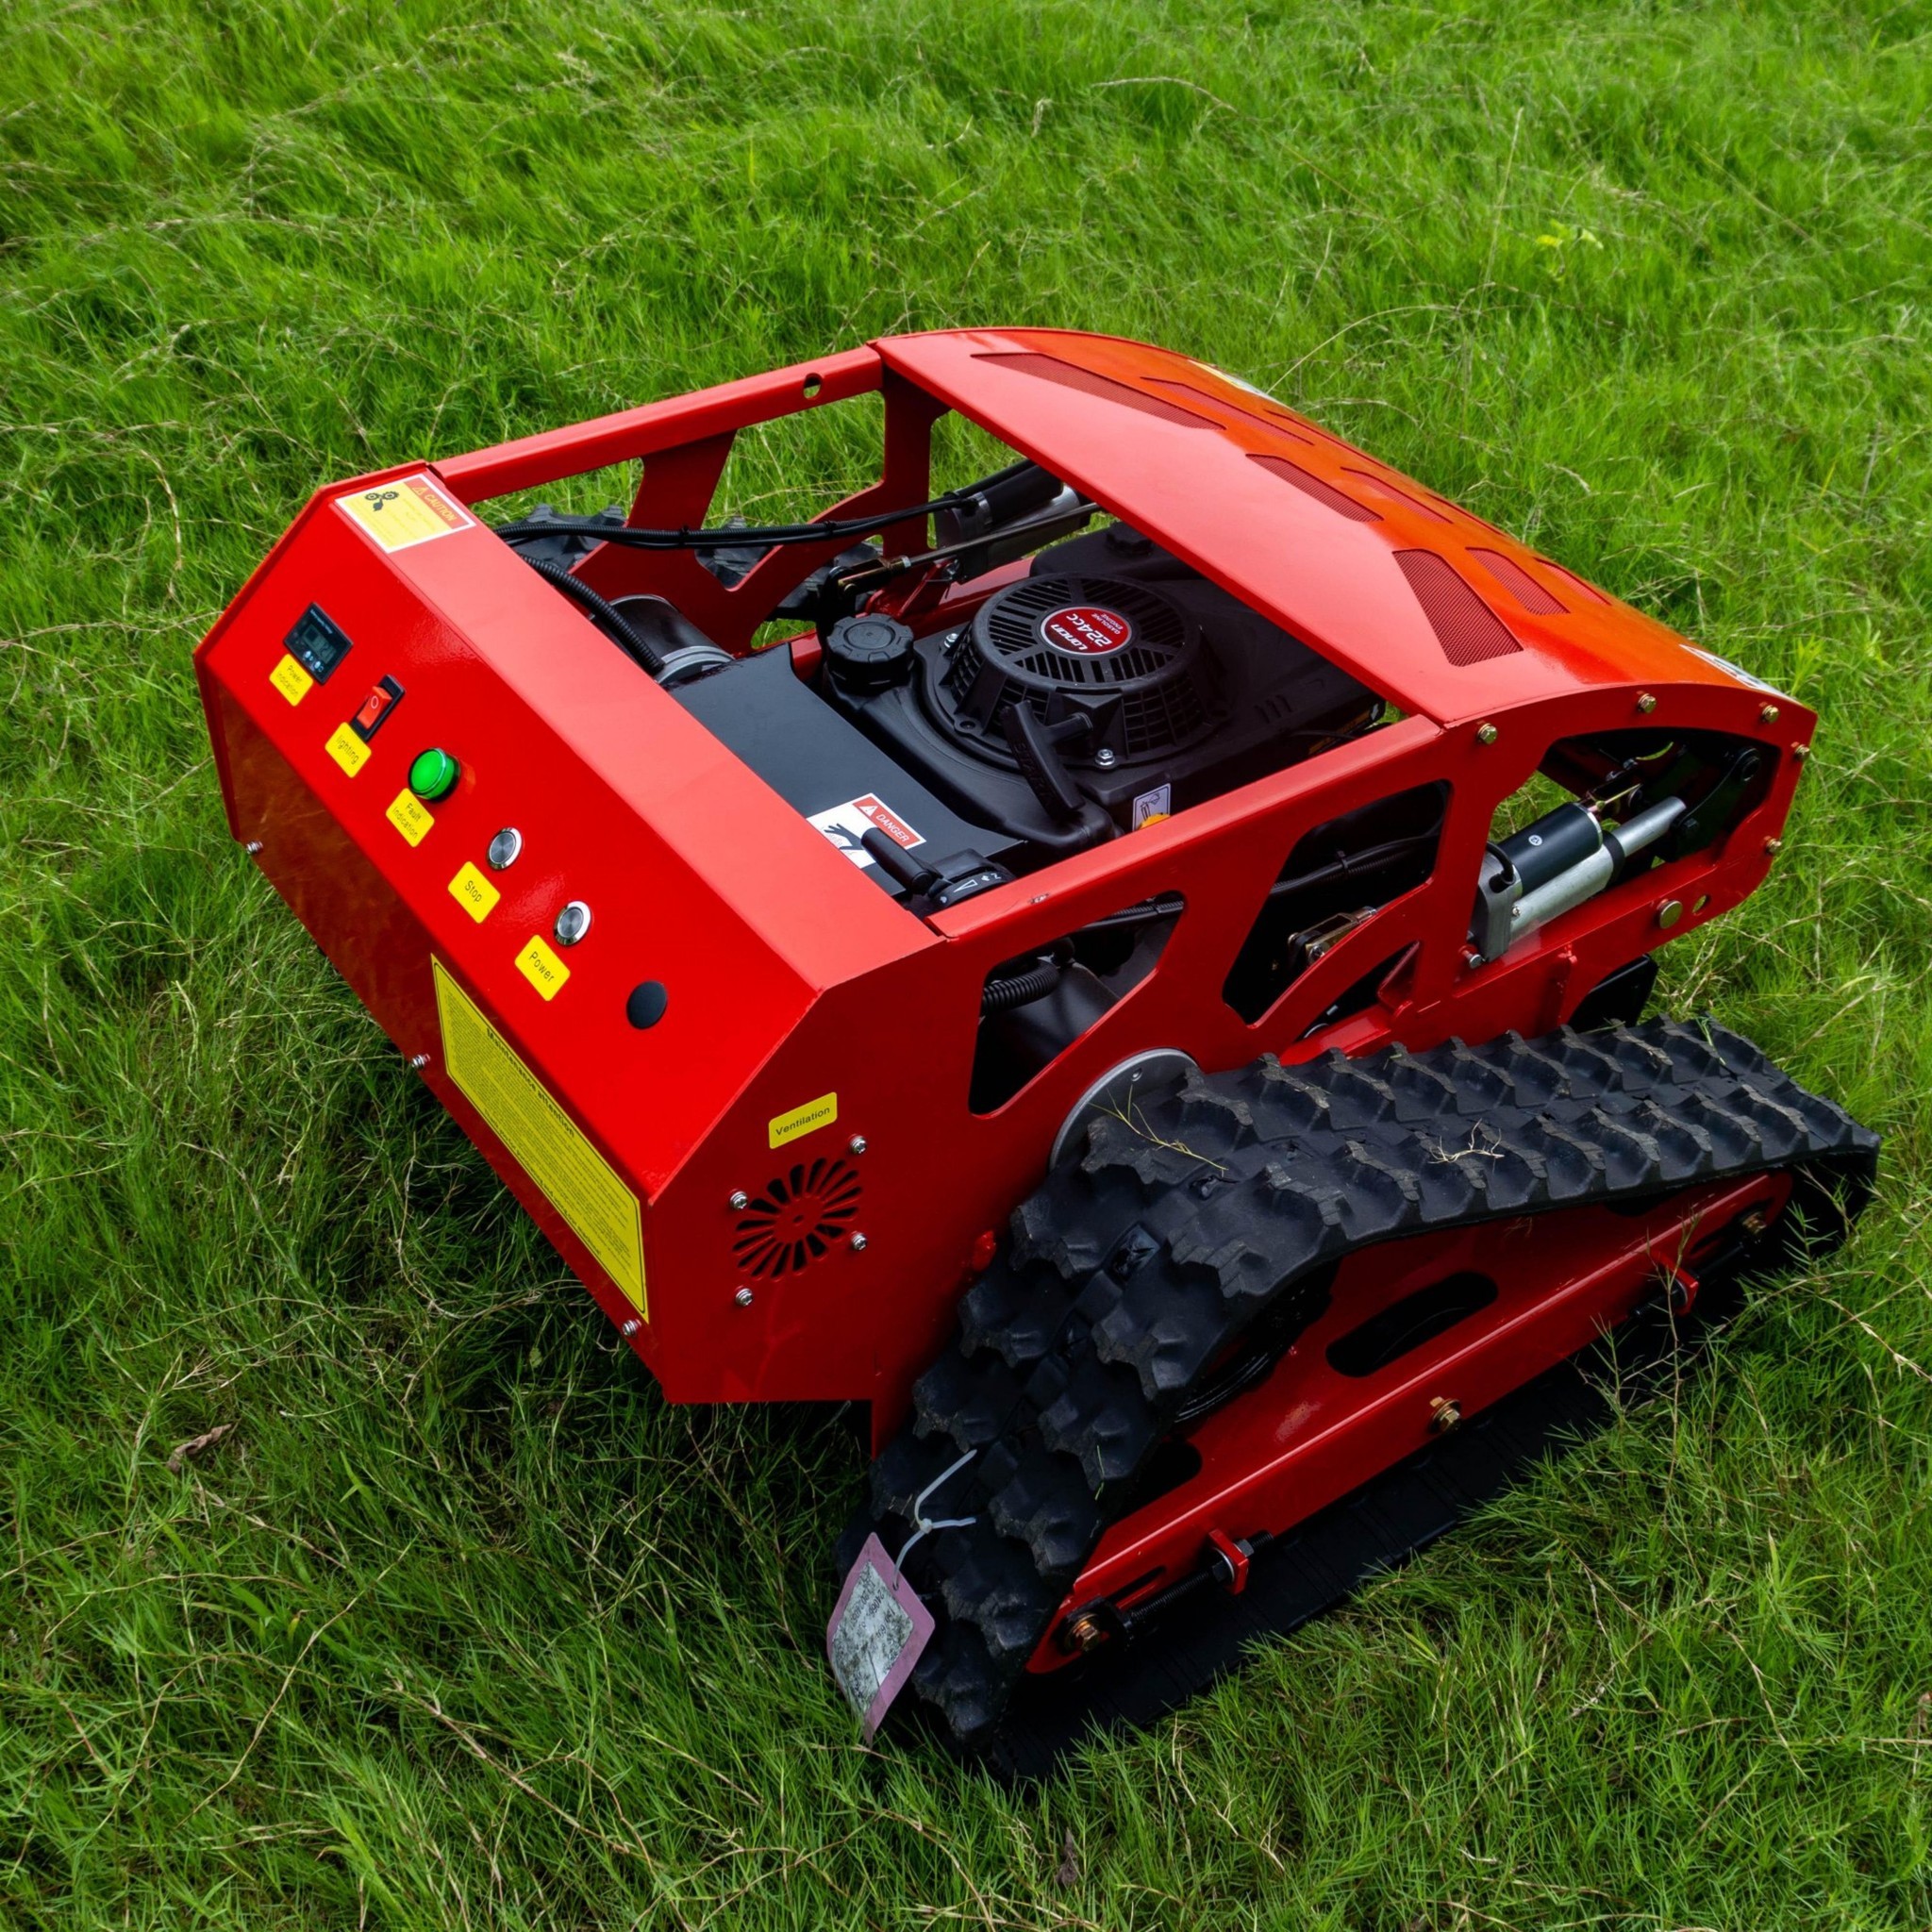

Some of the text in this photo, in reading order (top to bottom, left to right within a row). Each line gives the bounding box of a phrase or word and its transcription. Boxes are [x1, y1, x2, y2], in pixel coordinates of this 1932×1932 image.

[425, 495, 458, 521] CAUTION
[405, 802, 422, 823] Fault
[875, 813, 910, 842] DANGER
[464, 880, 482, 903] Stop
[529, 951, 555, 982] Power
[775, 1108, 830, 1136] Ventilation
